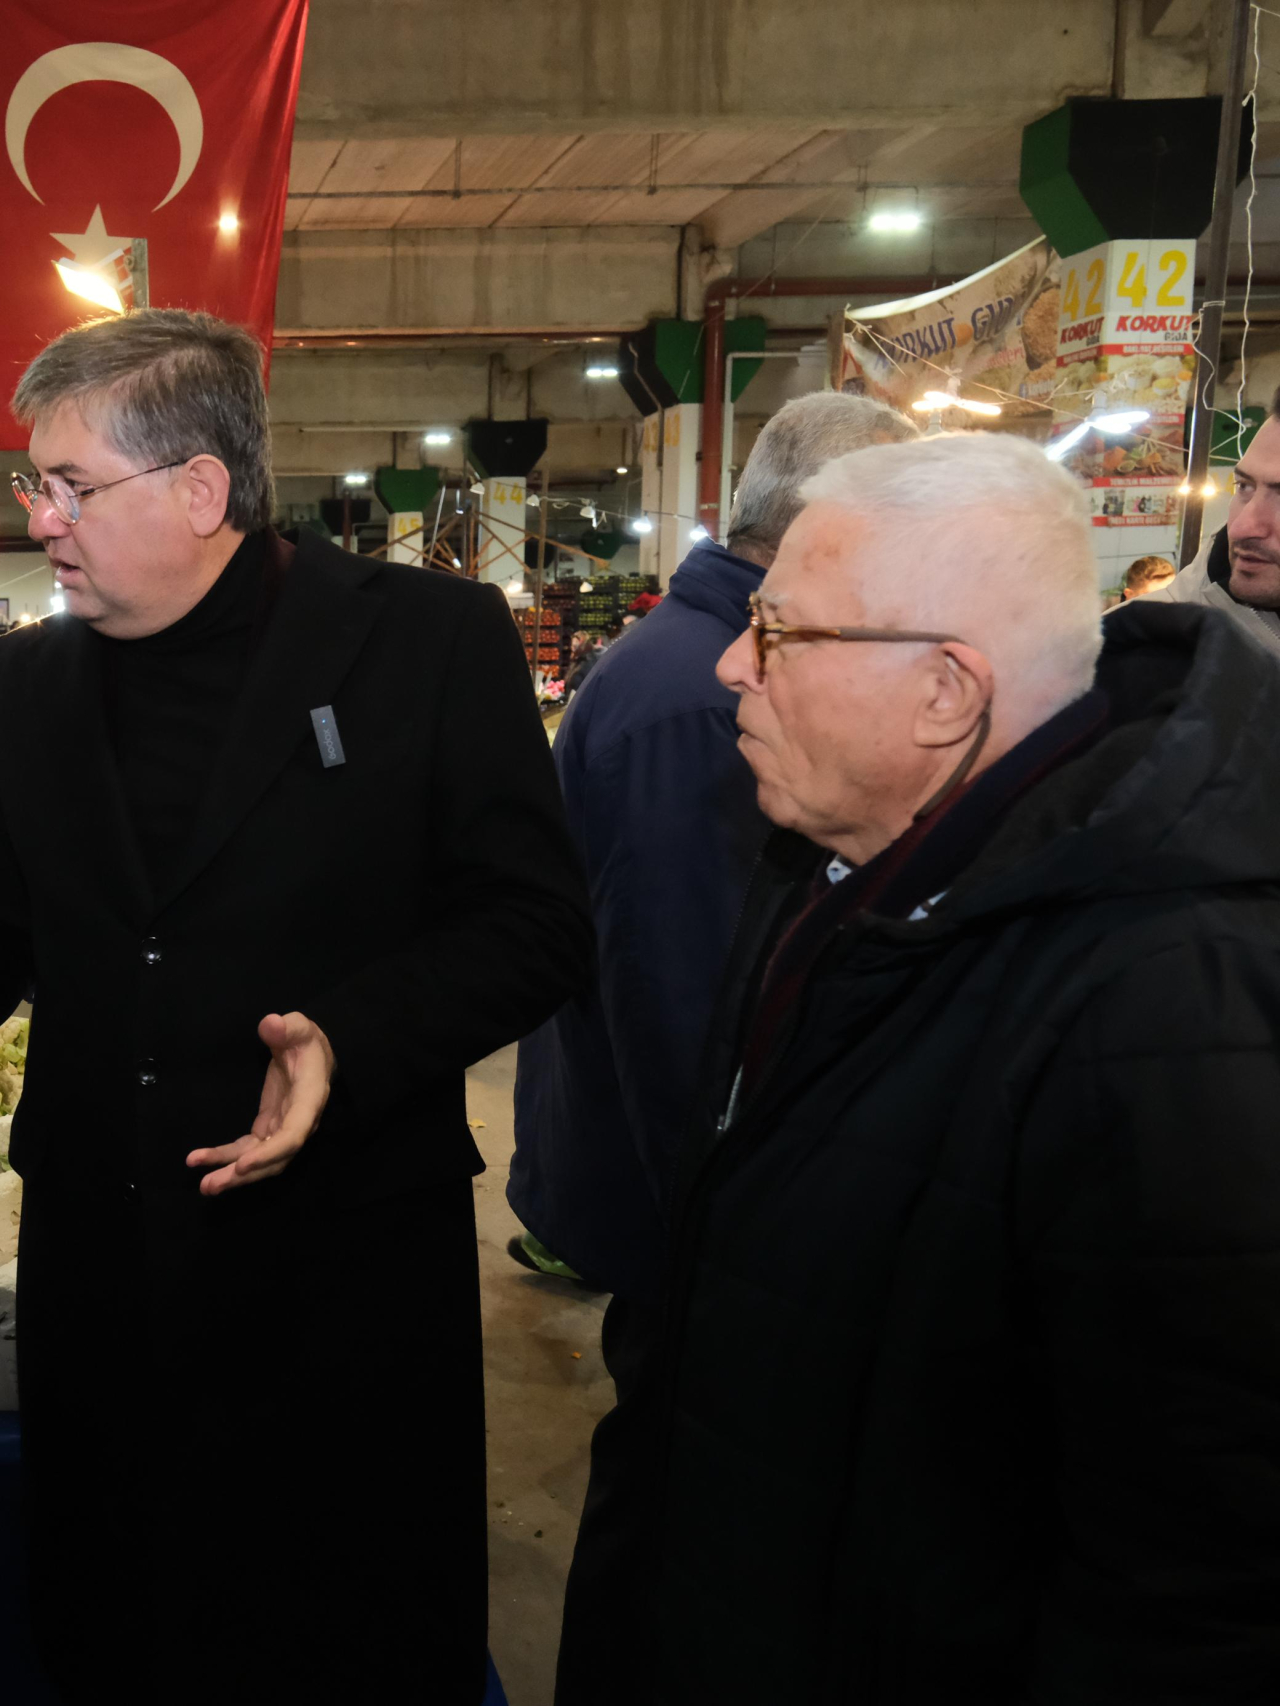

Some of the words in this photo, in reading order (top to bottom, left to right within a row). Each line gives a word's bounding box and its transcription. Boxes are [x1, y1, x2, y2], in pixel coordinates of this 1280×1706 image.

[1063, 258, 1105, 322] 42
[1117, 249, 1187, 308] 42
[1060, 316, 1104, 344] KORKUT
[1116, 315, 1193, 333] KORKUT
[494, 482, 523, 505] 44
